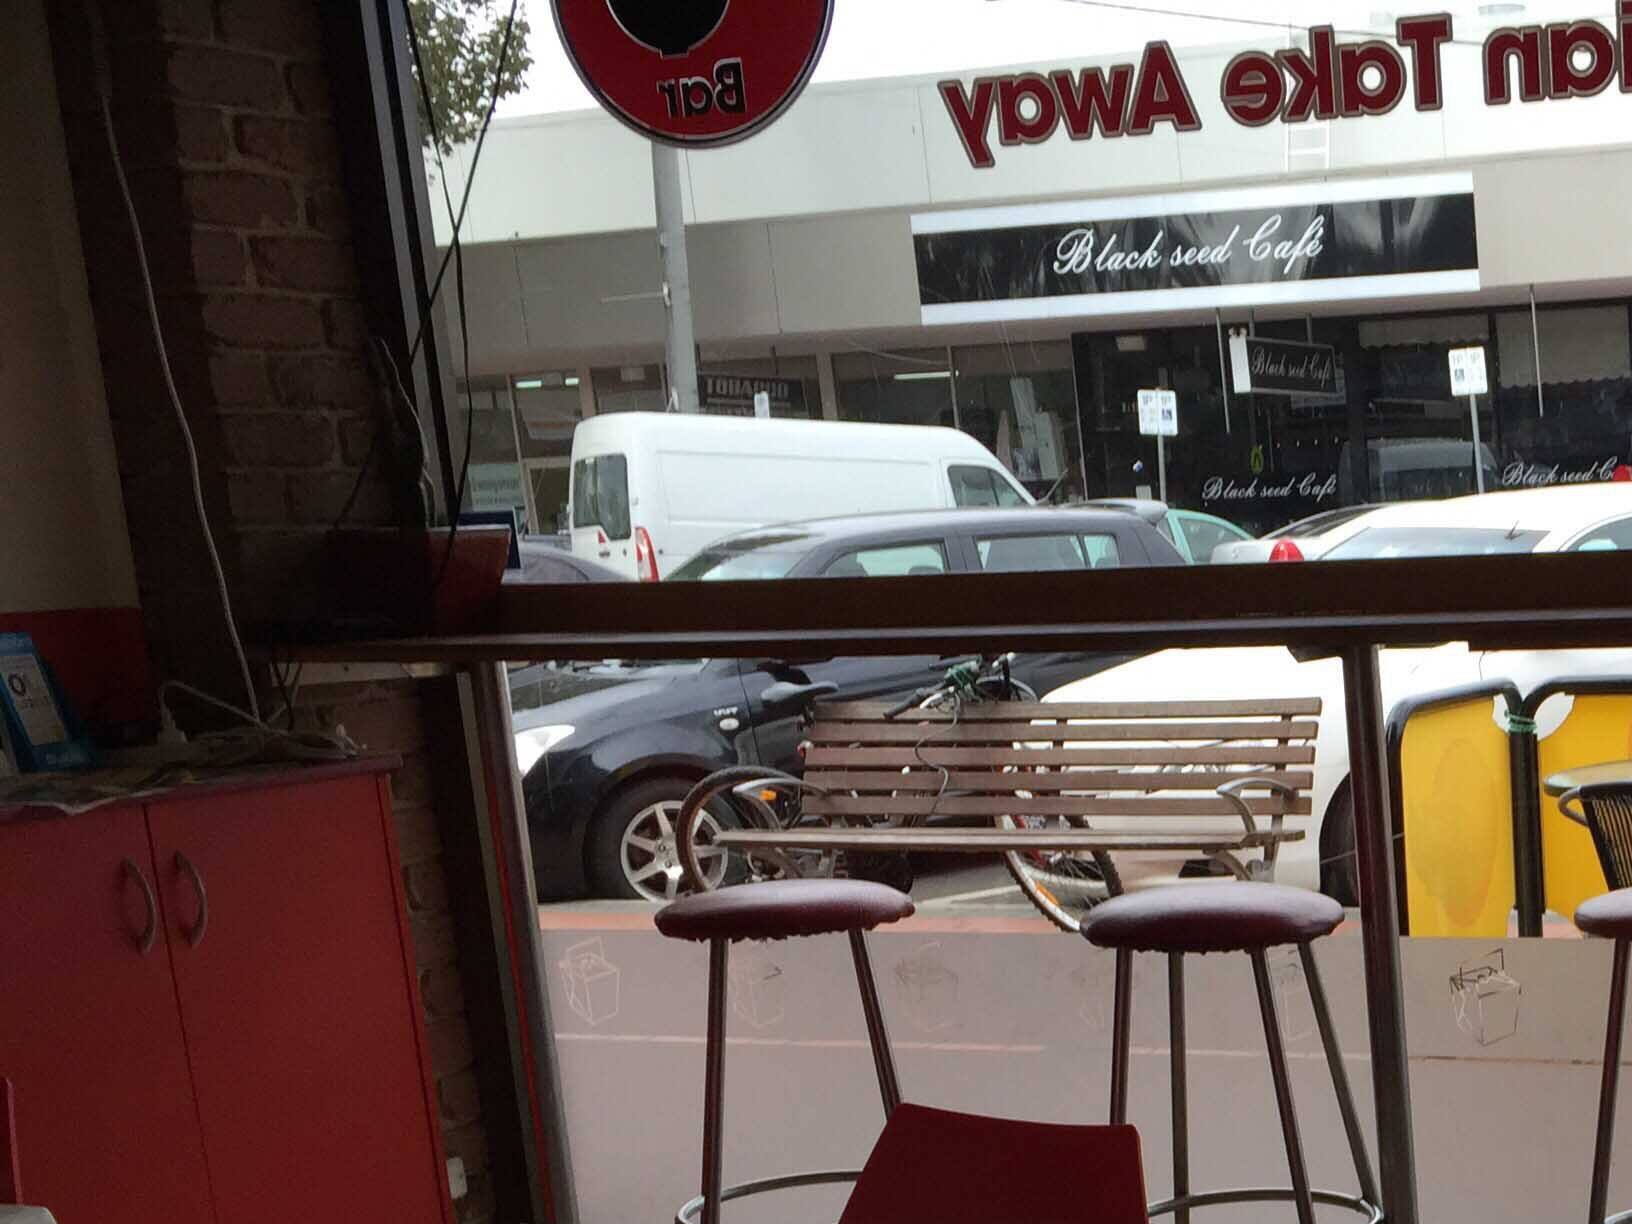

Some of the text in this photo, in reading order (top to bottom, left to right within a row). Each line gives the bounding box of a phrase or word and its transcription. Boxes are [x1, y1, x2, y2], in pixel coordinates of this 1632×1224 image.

[1053, 213, 1325, 275] Black seed Café
[1251, 344, 1287, 377] Black
[1288, 354, 1309, 379] seed
[1202, 475, 1257, 500] Black
[1259, 475, 1296, 498] seed
[1502, 461, 1558, 486] Black
[1559, 460, 1599, 482] seed
